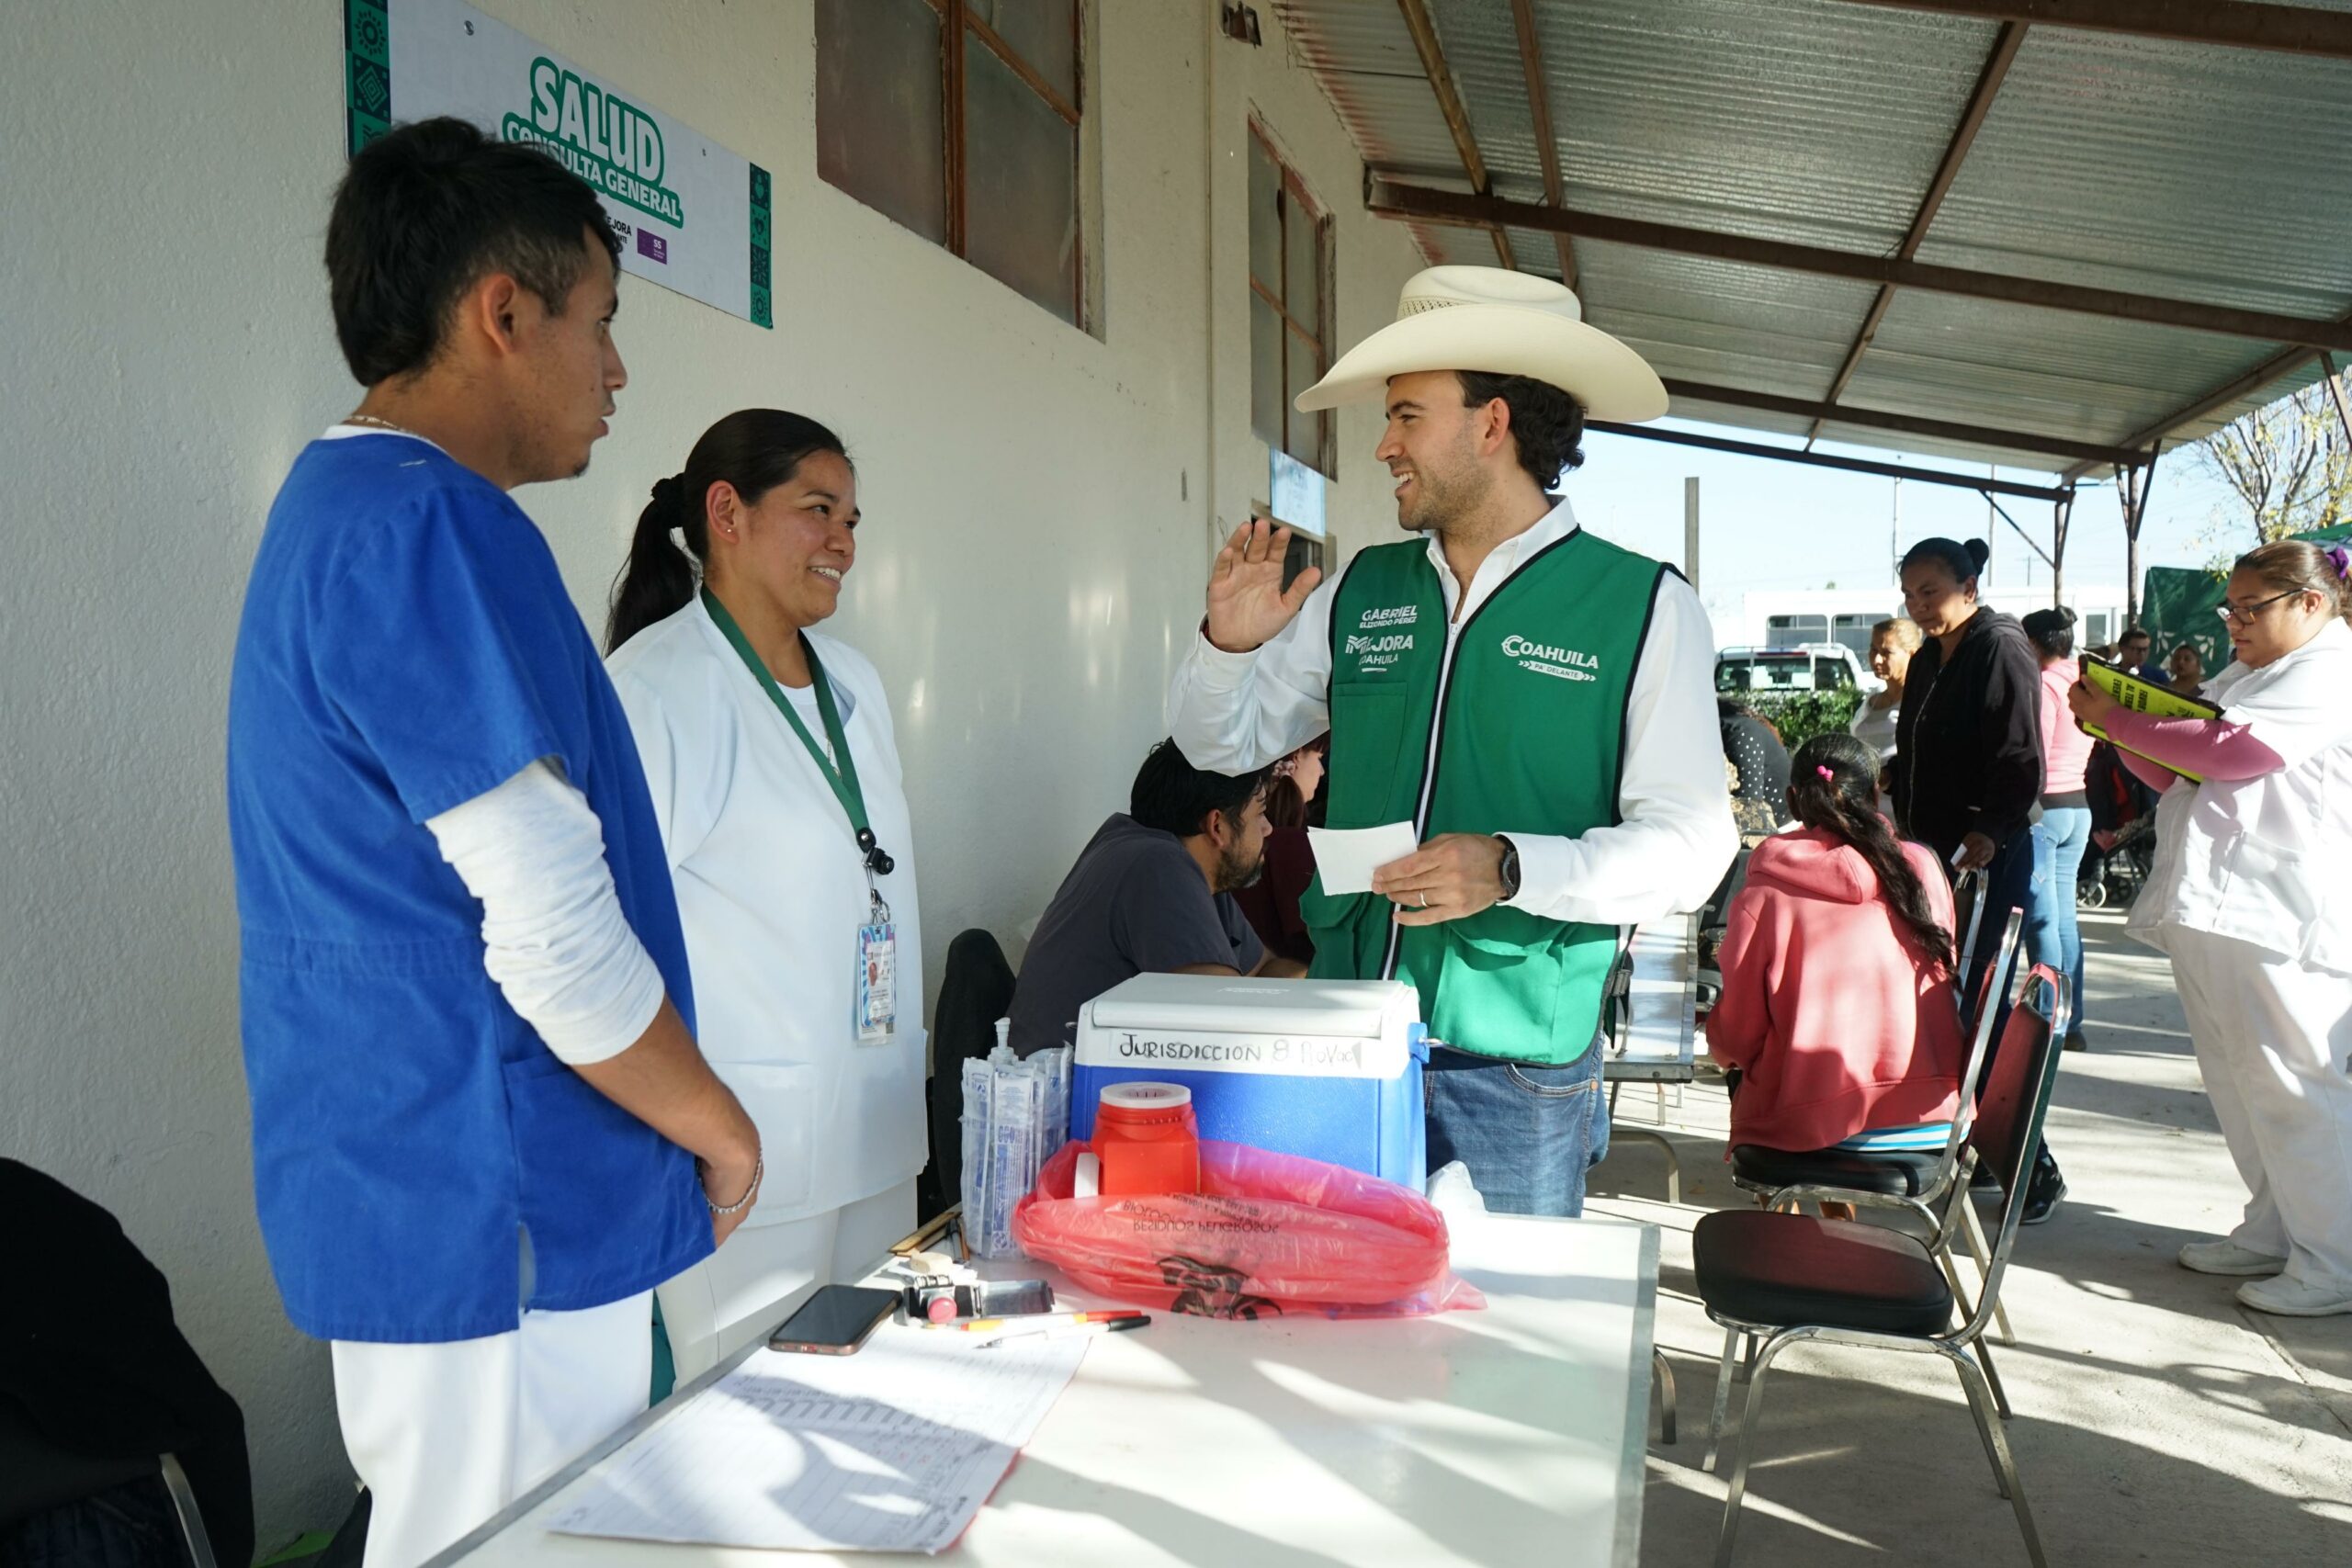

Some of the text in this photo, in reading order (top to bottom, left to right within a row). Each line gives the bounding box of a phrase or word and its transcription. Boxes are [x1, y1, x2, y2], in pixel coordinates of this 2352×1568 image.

[533, 61, 663, 184] SALUD
[506, 119, 682, 222] CONSULTA GENERAL
[606, 216, 632, 236] EJORA
[653, 239, 662, 250] SS
[1362, 604, 1419, 622] GABRIEL
[1359, 619, 1394, 629] ELIZONDO
[1500, 635, 1600, 670] COAHUILA
[1546, 666, 1579, 678] DELANTE
[1119, 1032, 1261, 1063] JURISDICCION
